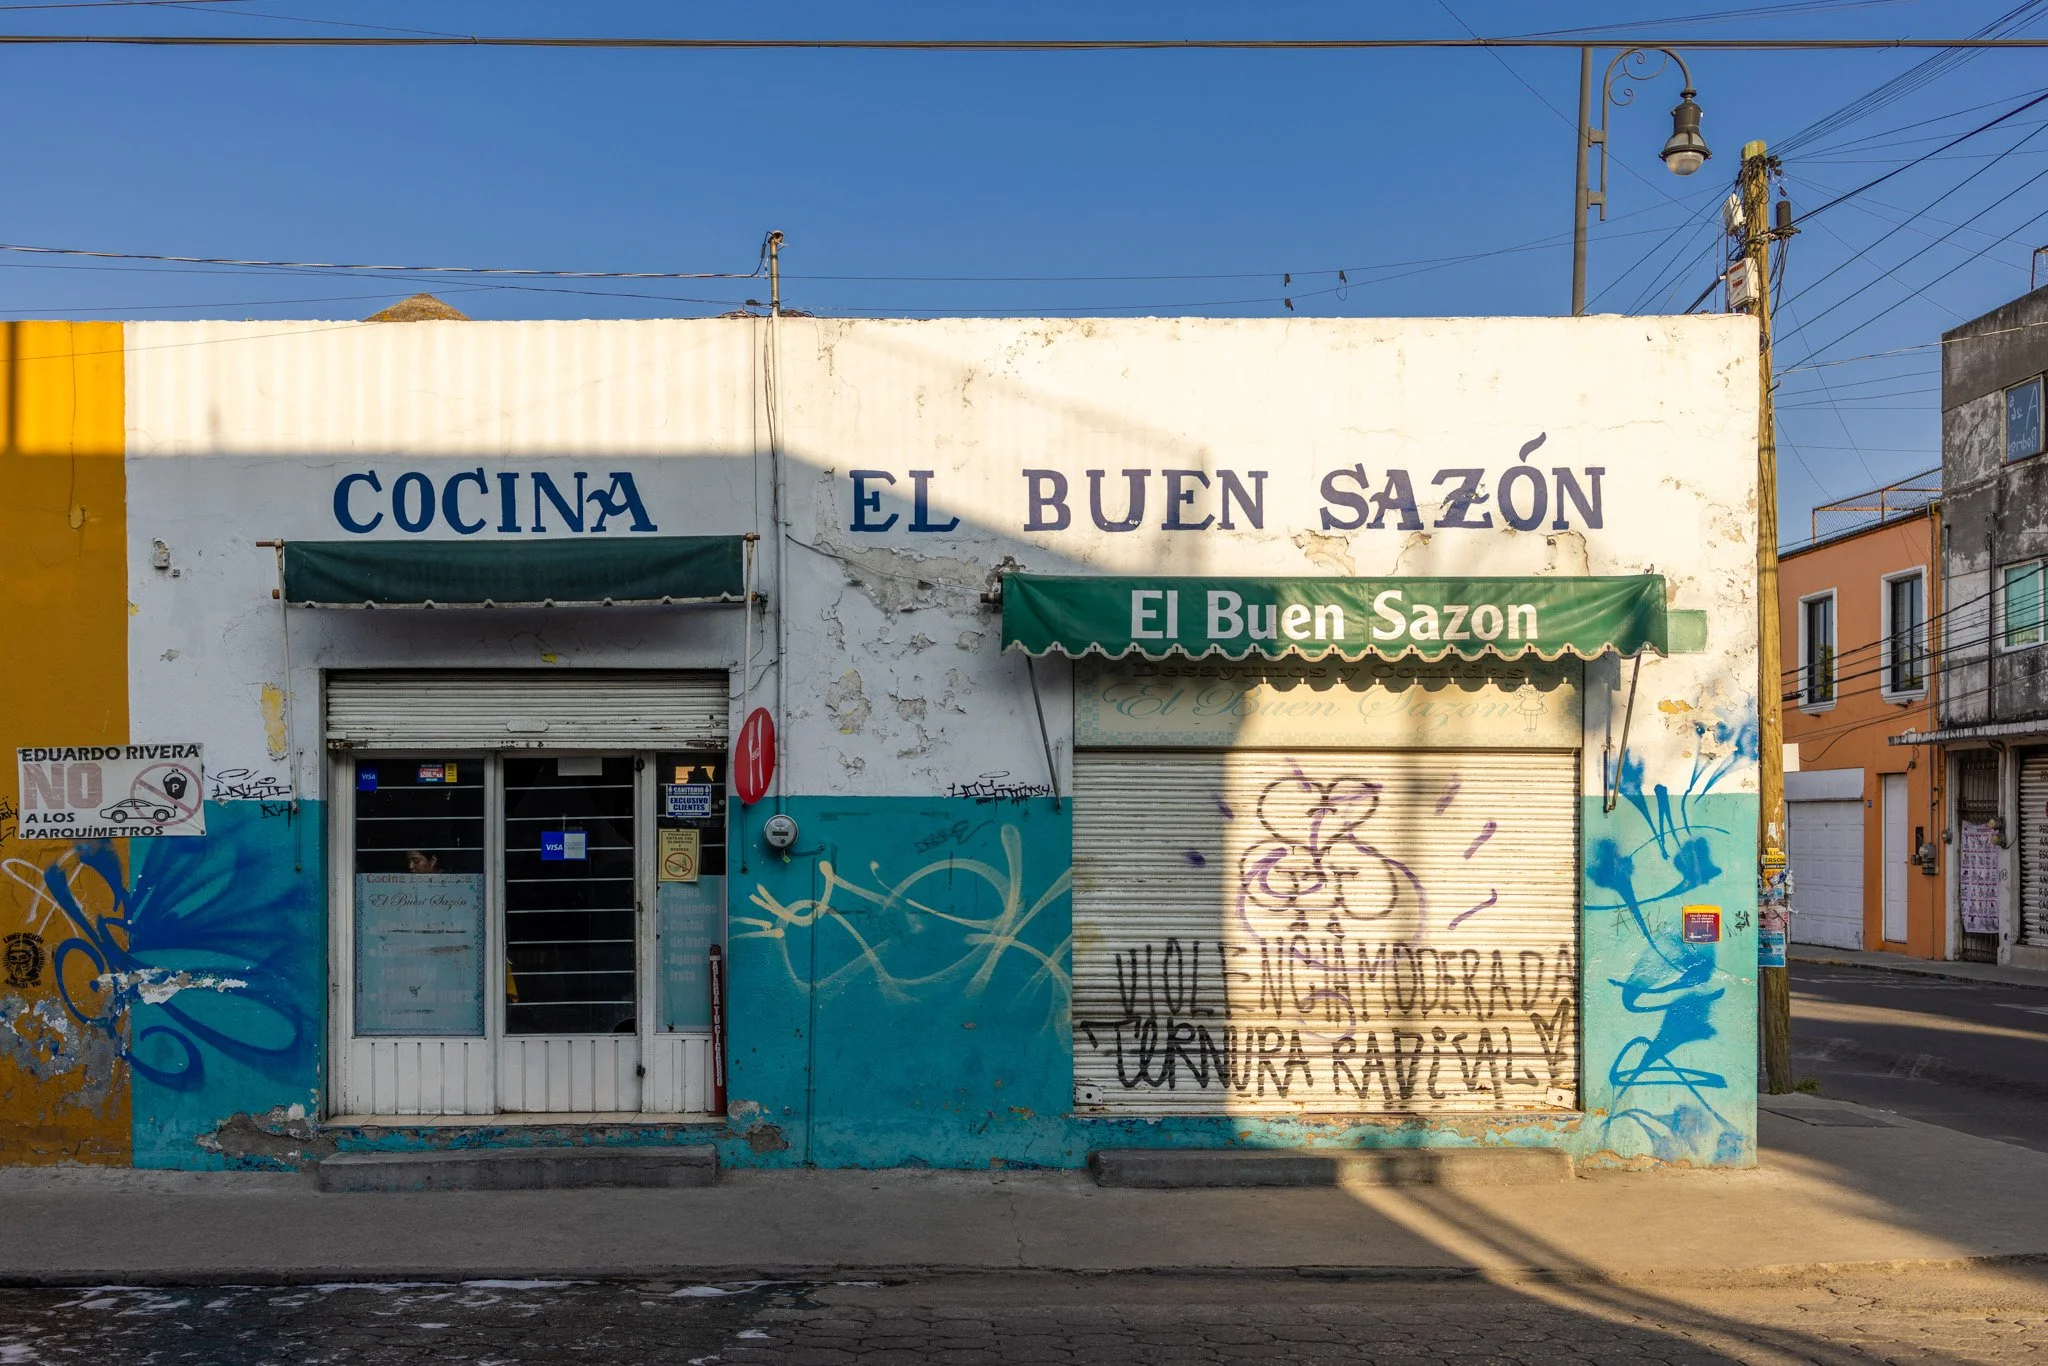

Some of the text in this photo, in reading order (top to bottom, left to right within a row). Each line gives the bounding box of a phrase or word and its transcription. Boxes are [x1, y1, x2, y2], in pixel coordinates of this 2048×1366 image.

[849, 431, 1606, 533] EL BUEN SAZÓN
[333, 467, 658, 535] COCINA
[1130, 589, 1539, 641] El Buen Sazon
[1132, 663, 1525, 682] Desayunos y Comidas
[1103, 681, 1517, 733] El Buen Sazón
[22, 744, 201, 762] EDUARDO RIVERA
[23, 762, 103, 811] NO
[673, 786, 705, 795] SANITARIO
[25, 812, 75, 823] A LOS
[25, 825, 164, 839] PARQUÍMETROS
[546, 843, 563, 851] VISA
[390, 889, 426, 909] Buen
[429, 892, 468, 911] Sazón
[1358, 938, 1575, 1021] MODERADA
[712, 960, 723, 1087] APAGA TU CIGARRO
